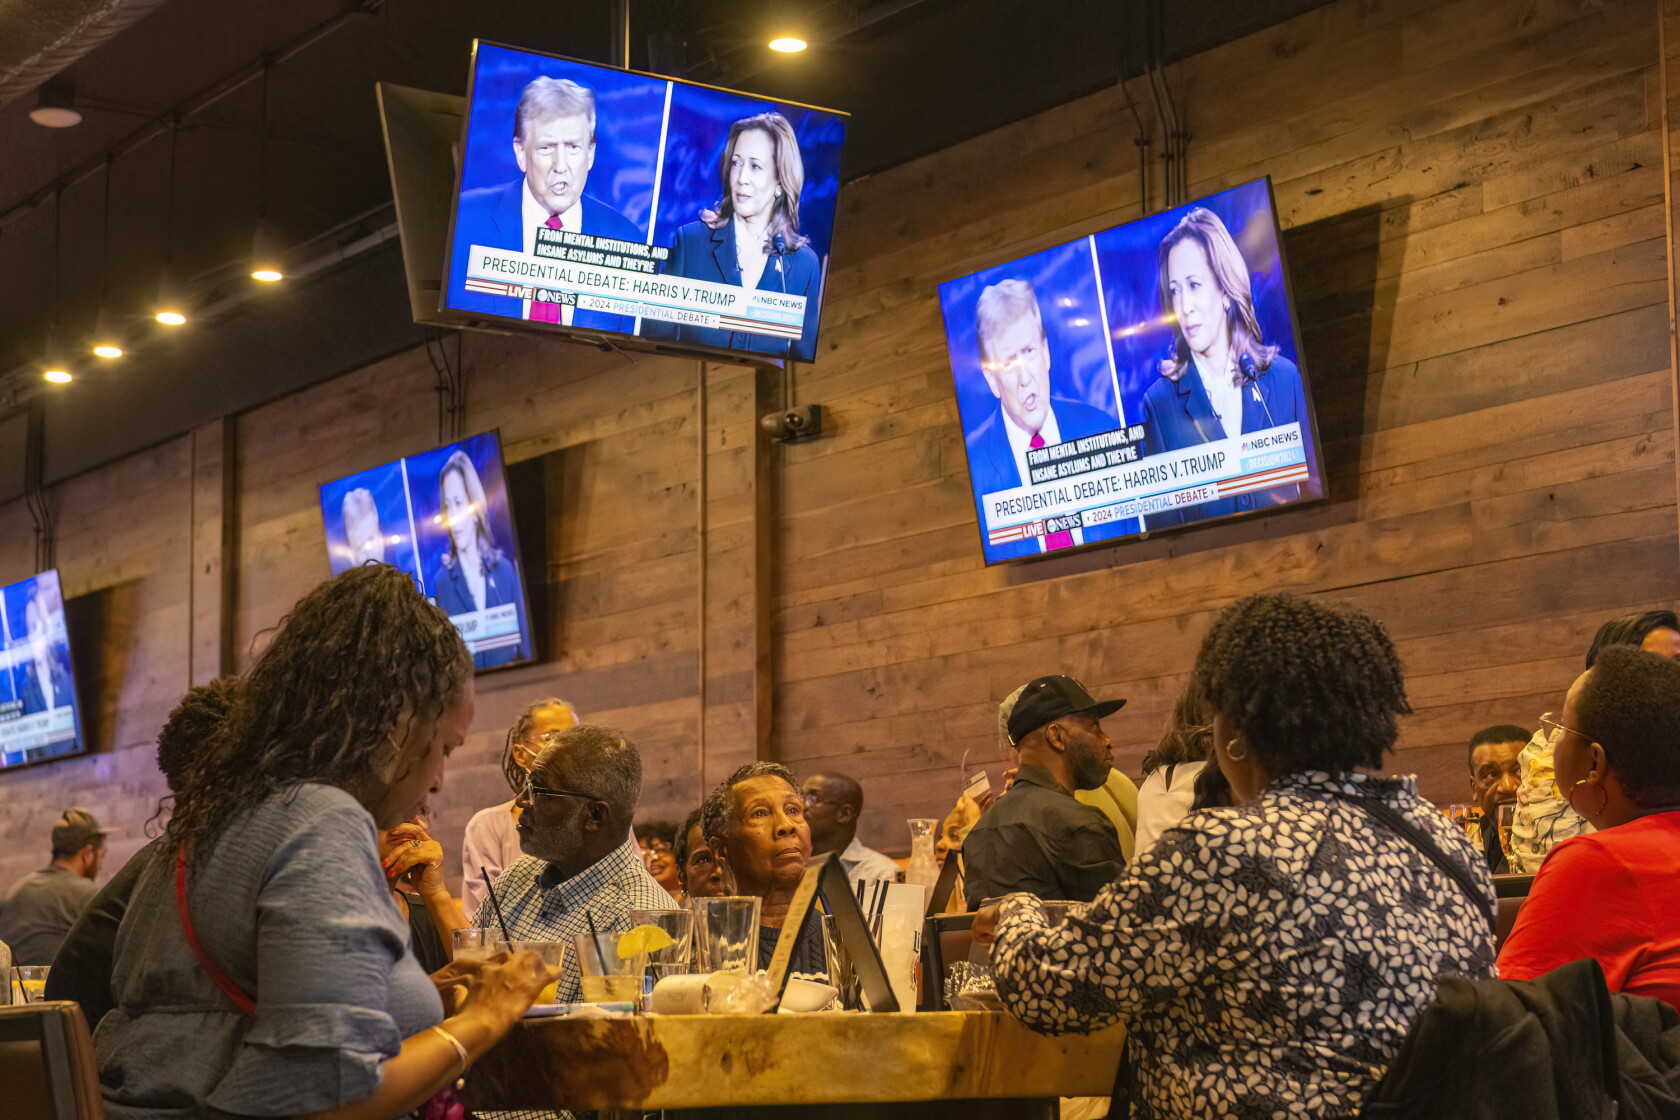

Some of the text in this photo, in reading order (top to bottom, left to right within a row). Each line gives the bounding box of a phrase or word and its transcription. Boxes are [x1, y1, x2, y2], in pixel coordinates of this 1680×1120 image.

[536, 243, 567, 259] INSANE
[567, 248, 604, 265] ASYLUMS
[604, 255, 622, 268] AND
[539, 229, 563, 242] FROM
[563, 232, 595, 249] MENTAL
[652, 246, 669, 260] AND
[482, 256, 574, 283] PRESIDENTIAL
[577, 270, 630, 292] DEBATE:
[632, 280, 678, 299] HARRIS
[508, 285, 533, 298] LIVE
[589, 298, 709, 324] 2024 PRESIDENTIAL DEBATE
[761, 296, 803, 309] NBC NEWS
[1029, 450, 1050, 466] FROM
[1049, 442, 1078, 461] MENTAL
[1128, 424, 1145, 441] AND
[1251, 430, 1299, 449] NBC NEWS
[1031, 466, 1059, 483] INSANE
[1058, 457, 1092, 477] ASYLUMS
[1091, 453, 1107, 469] AND
[995, 486, 1072, 518] PRESIDENTIAL
[1074, 474, 1122, 500] DEBATE:
[1124, 466, 1167, 489] HARRIS
[1092, 487, 1208, 523] 2024 PRESIDENTIAL DEBATE
[1022, 524, 1045, 539] LIVE
